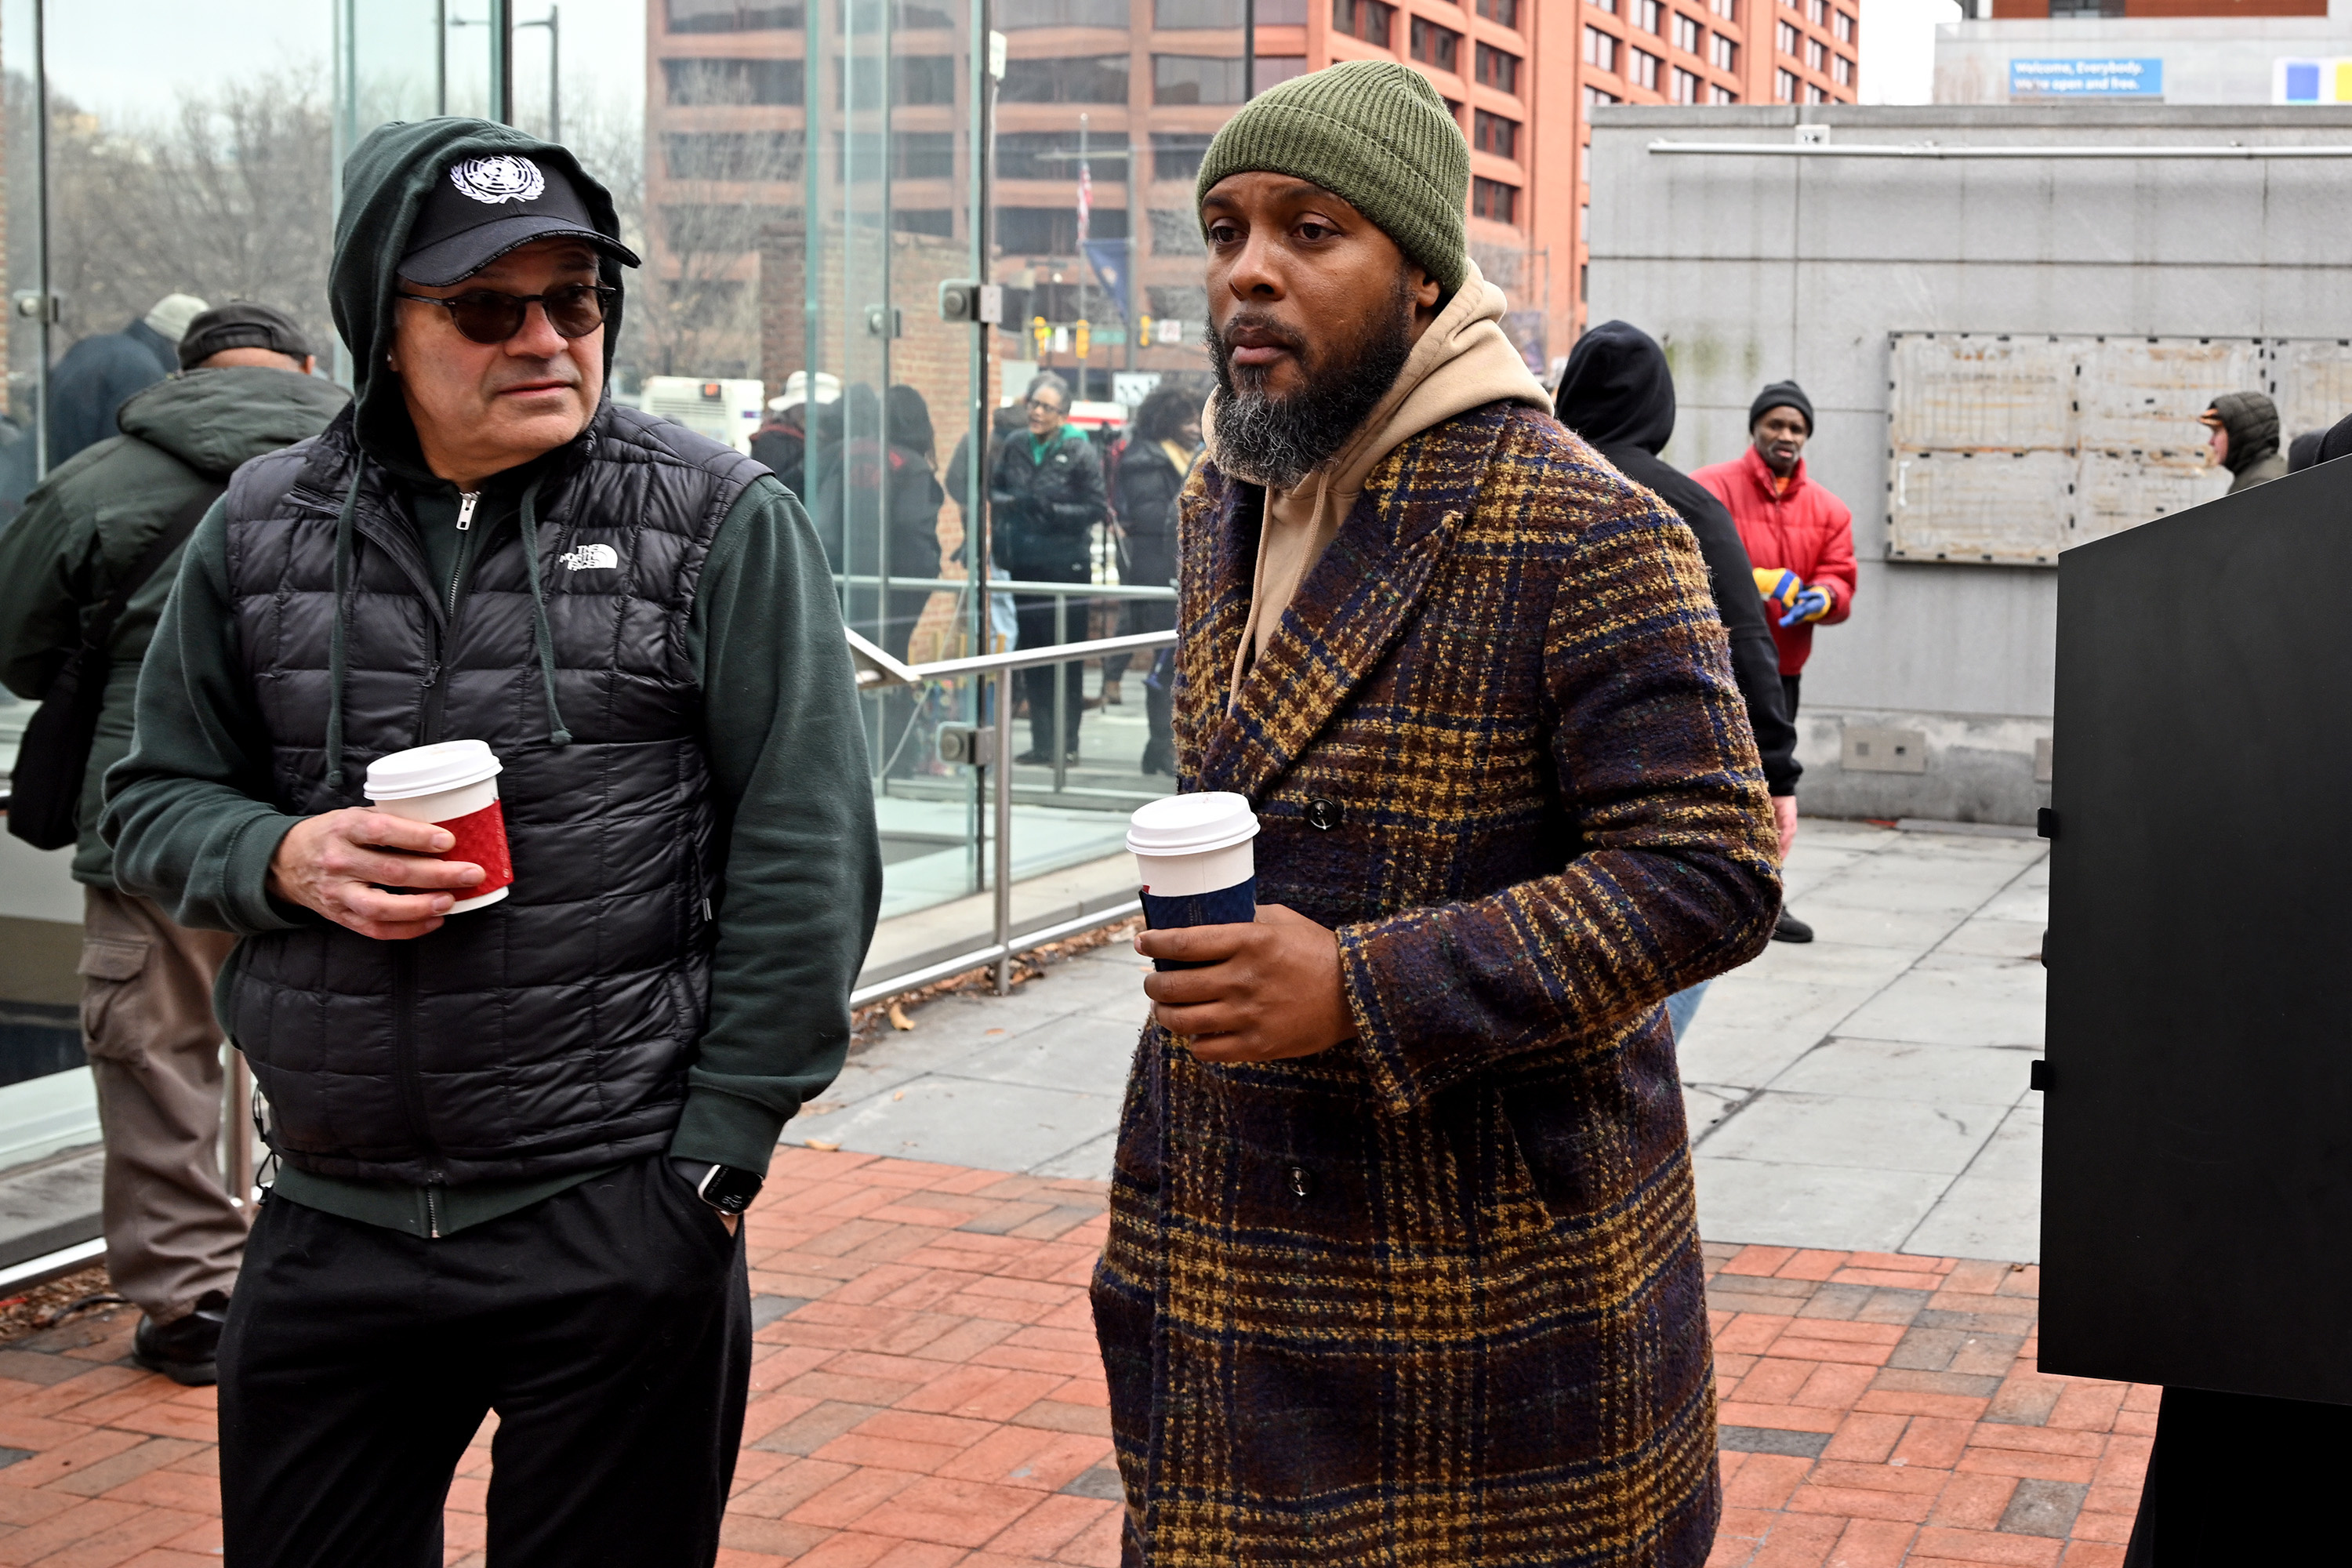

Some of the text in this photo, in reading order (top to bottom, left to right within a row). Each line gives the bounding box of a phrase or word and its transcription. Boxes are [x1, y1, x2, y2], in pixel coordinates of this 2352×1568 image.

[2014, 61, 2144, 76] Welcome, Everybody.
[2052, 79, 2084, 92] open
[2085, 78, 2110, 89] and
[576, 544, 599, 554] THE
